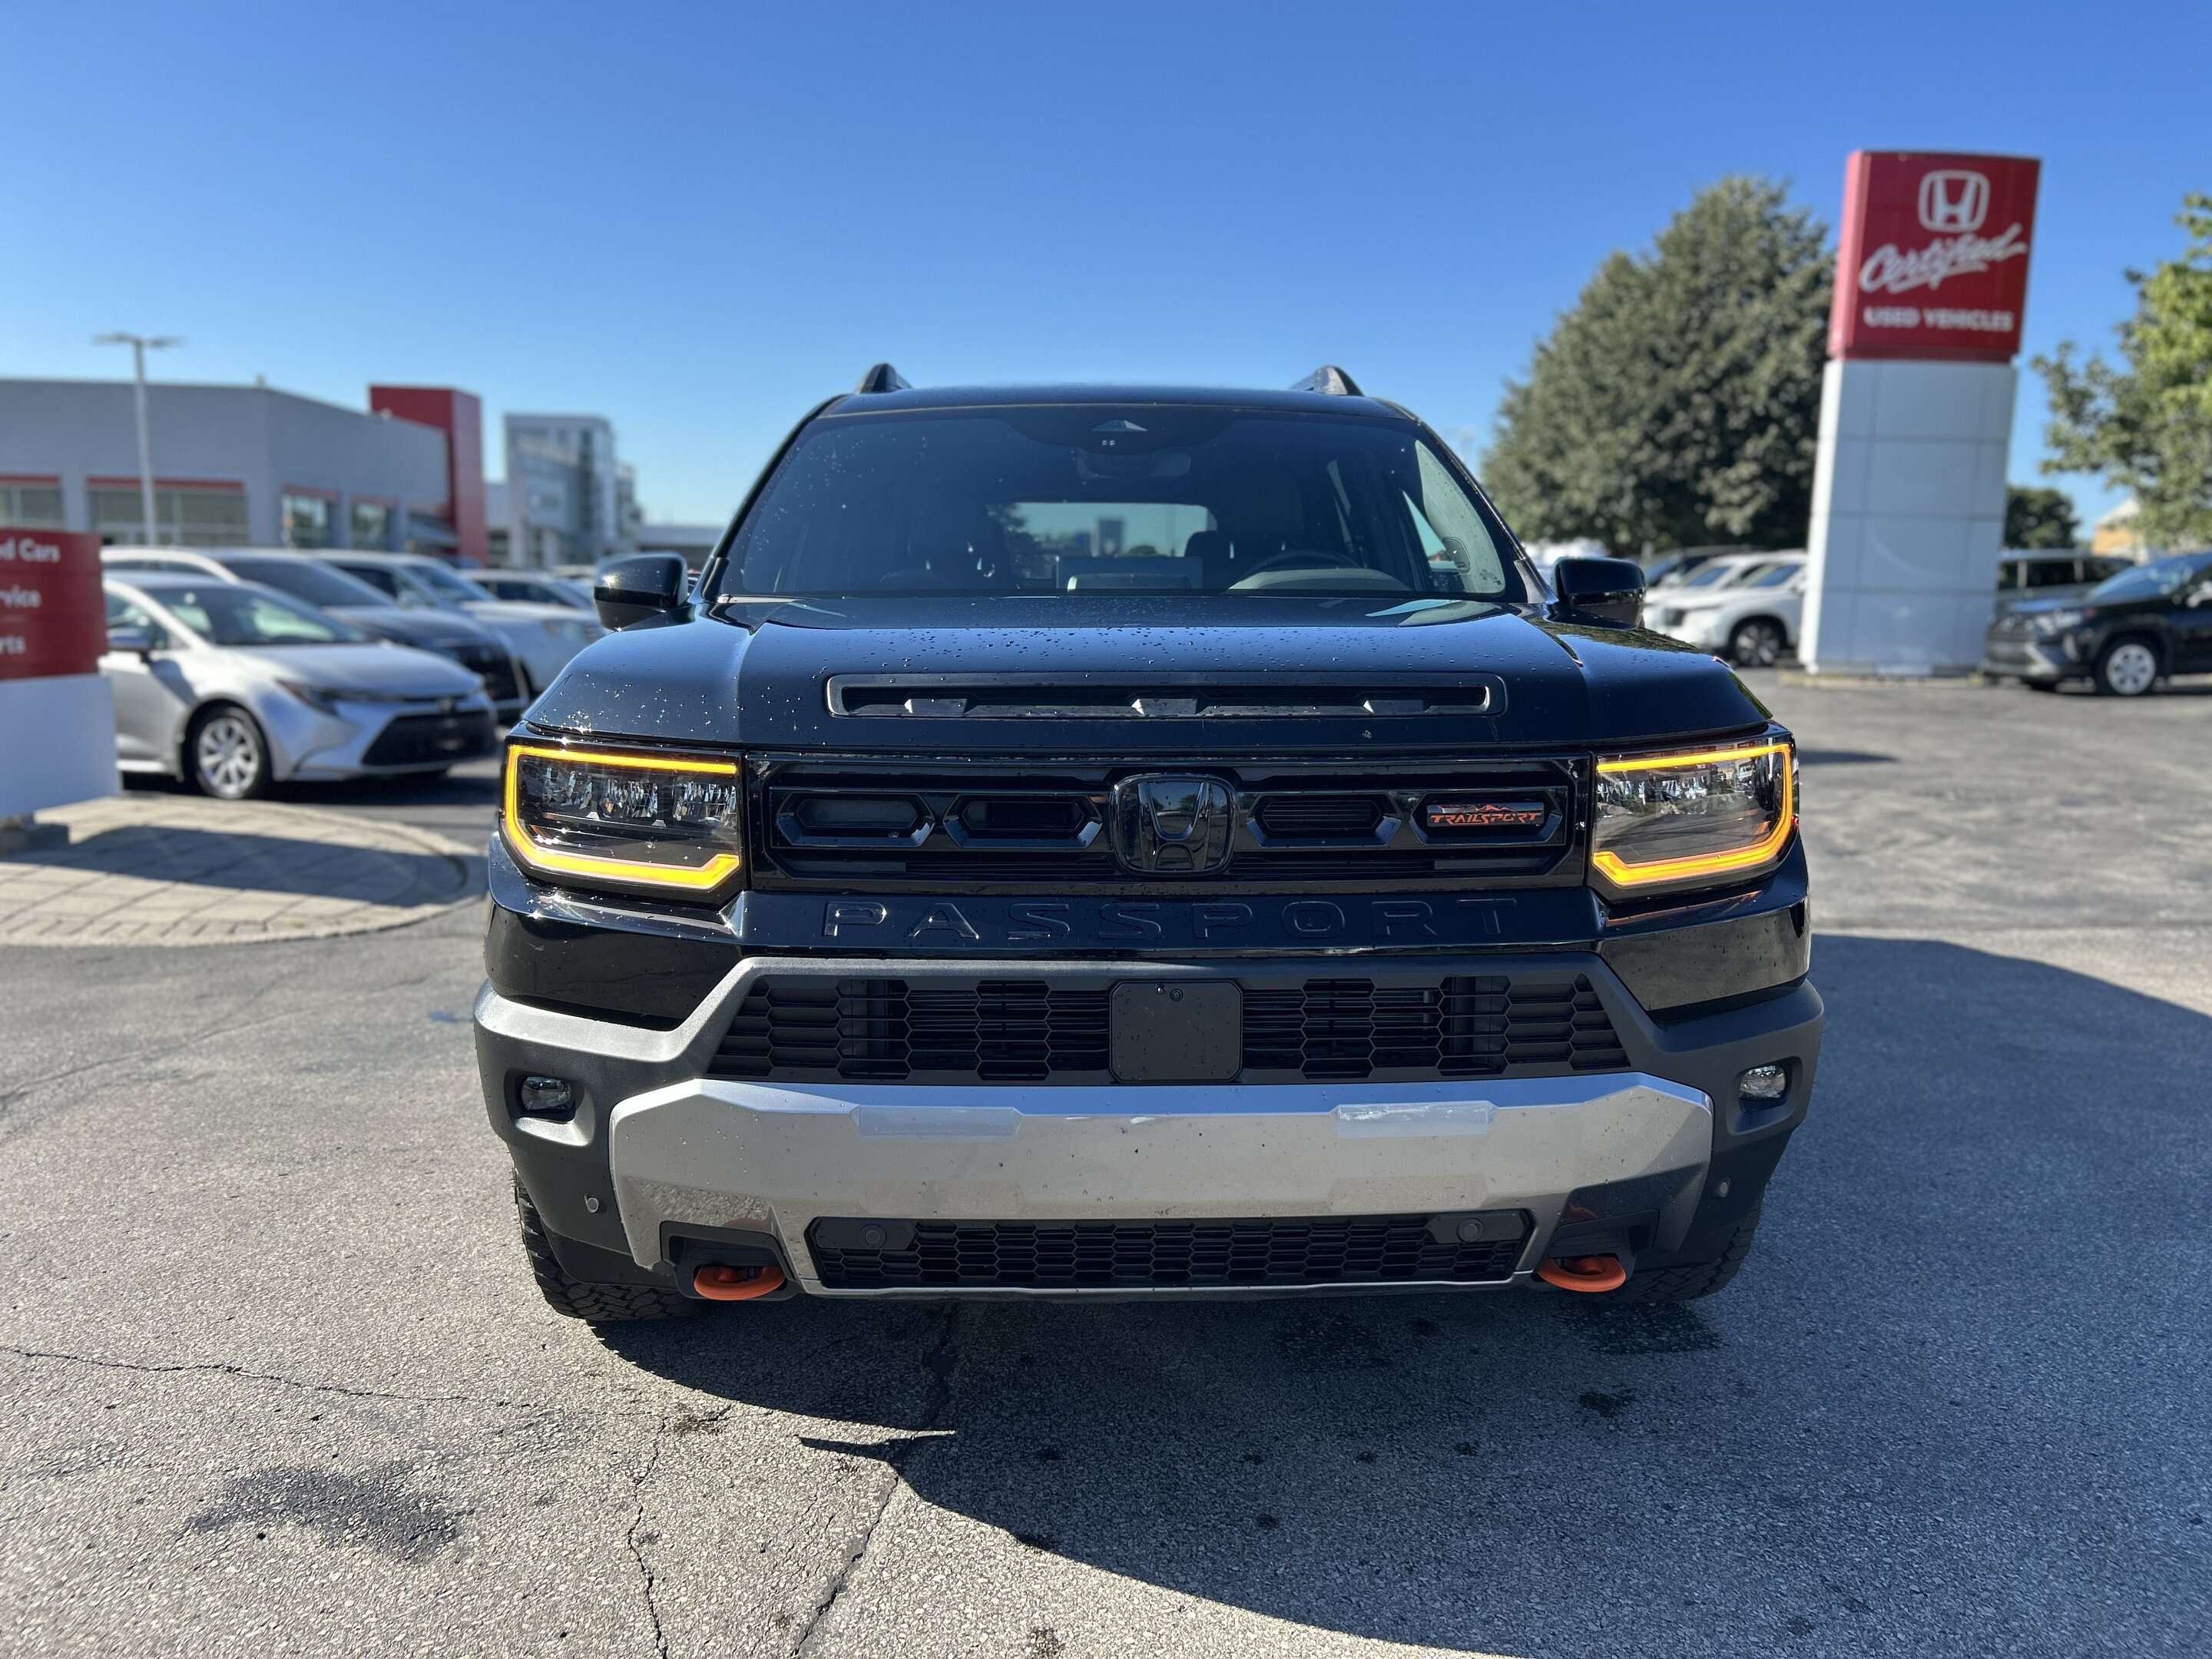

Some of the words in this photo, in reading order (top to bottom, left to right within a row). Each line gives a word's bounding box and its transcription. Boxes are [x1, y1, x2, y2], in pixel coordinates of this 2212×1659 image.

[1859, 223, 2027, 293] Certified
[1863, 306, 1920, 328] USED
[1923, 309, 2014, 333] VEHICLES
[19, 538, 61, 562] Cars
[1431, 813, 1541, 825] TRAILSPORT
[823, 899, 1518, 939] PASSPORT
